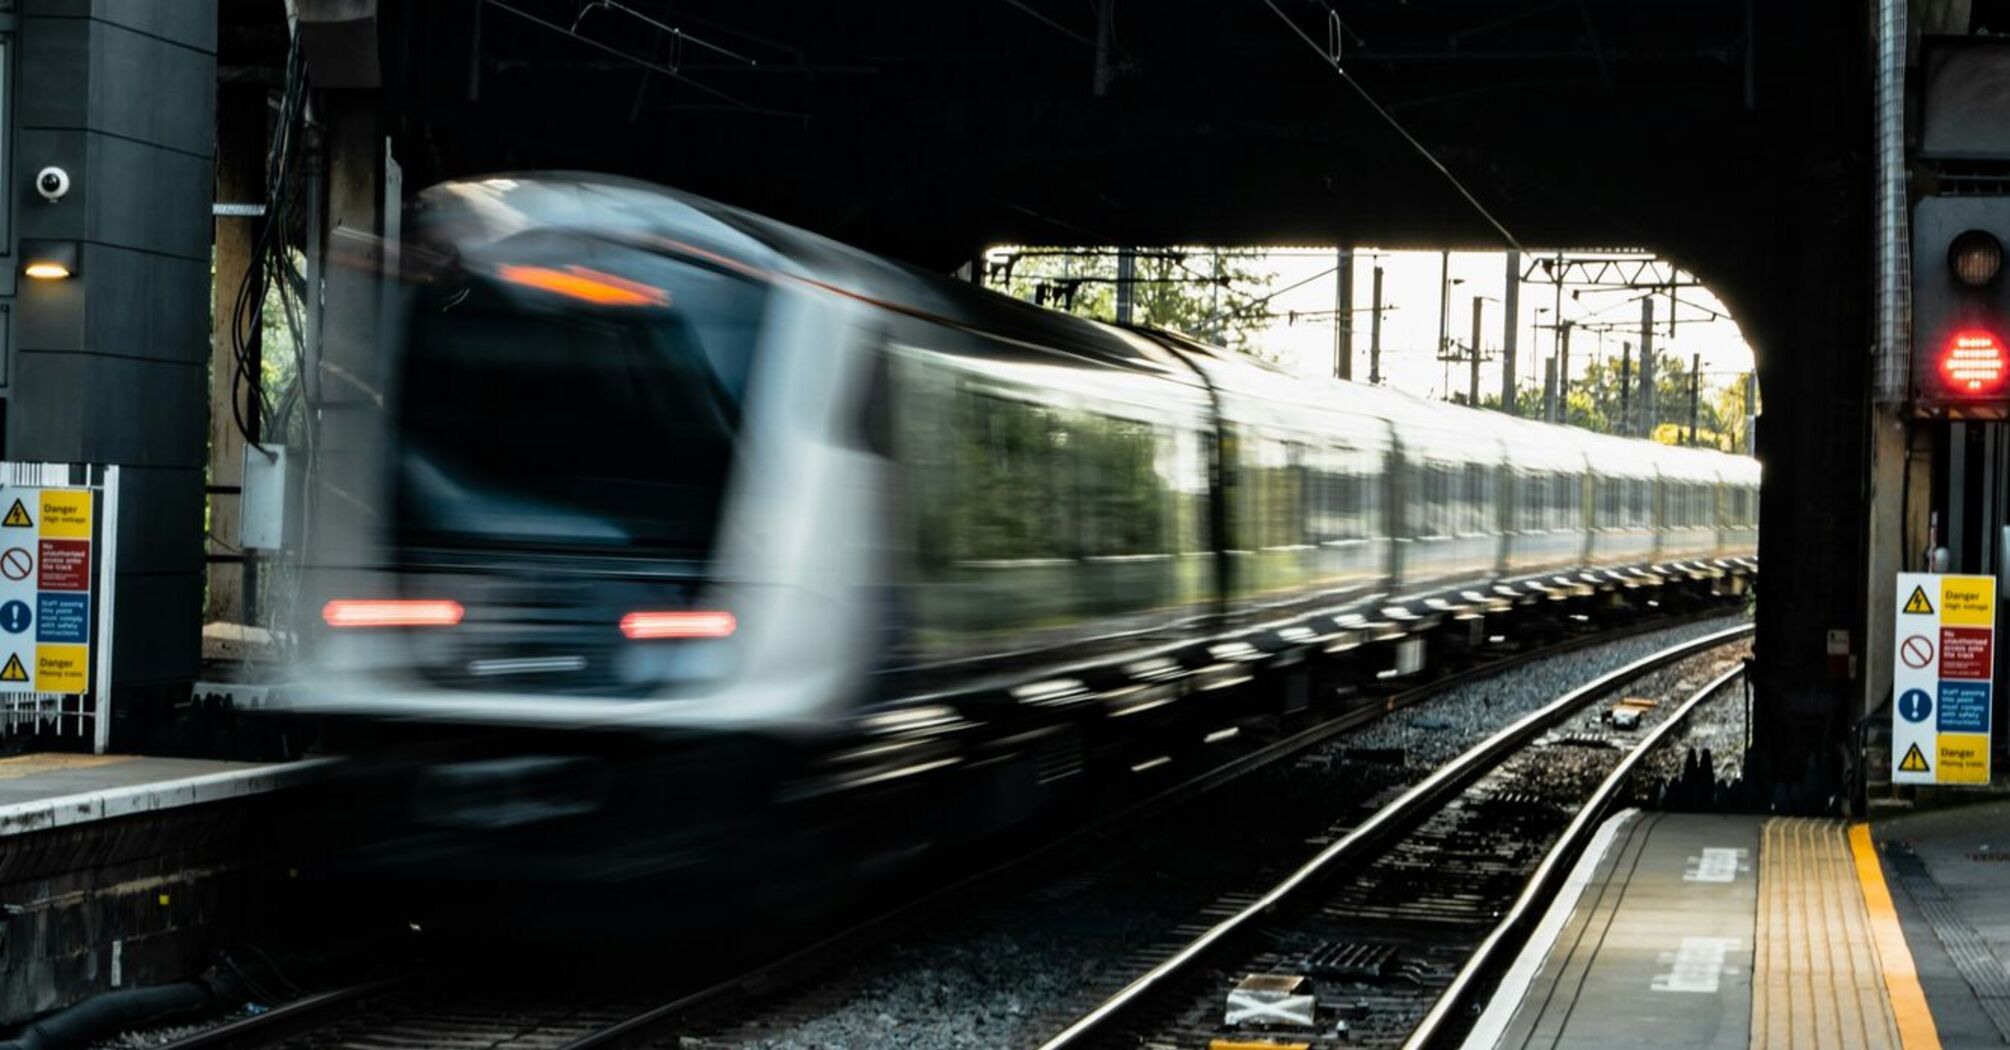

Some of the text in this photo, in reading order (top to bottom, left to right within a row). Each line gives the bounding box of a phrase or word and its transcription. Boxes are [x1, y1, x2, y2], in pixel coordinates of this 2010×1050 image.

[44, 504, 78, 515] Danger
[1945, 590, 1979, 602] Danger
[40, 657, 73, 669] Danger
[1941, 748, 1974, 759] Danger
